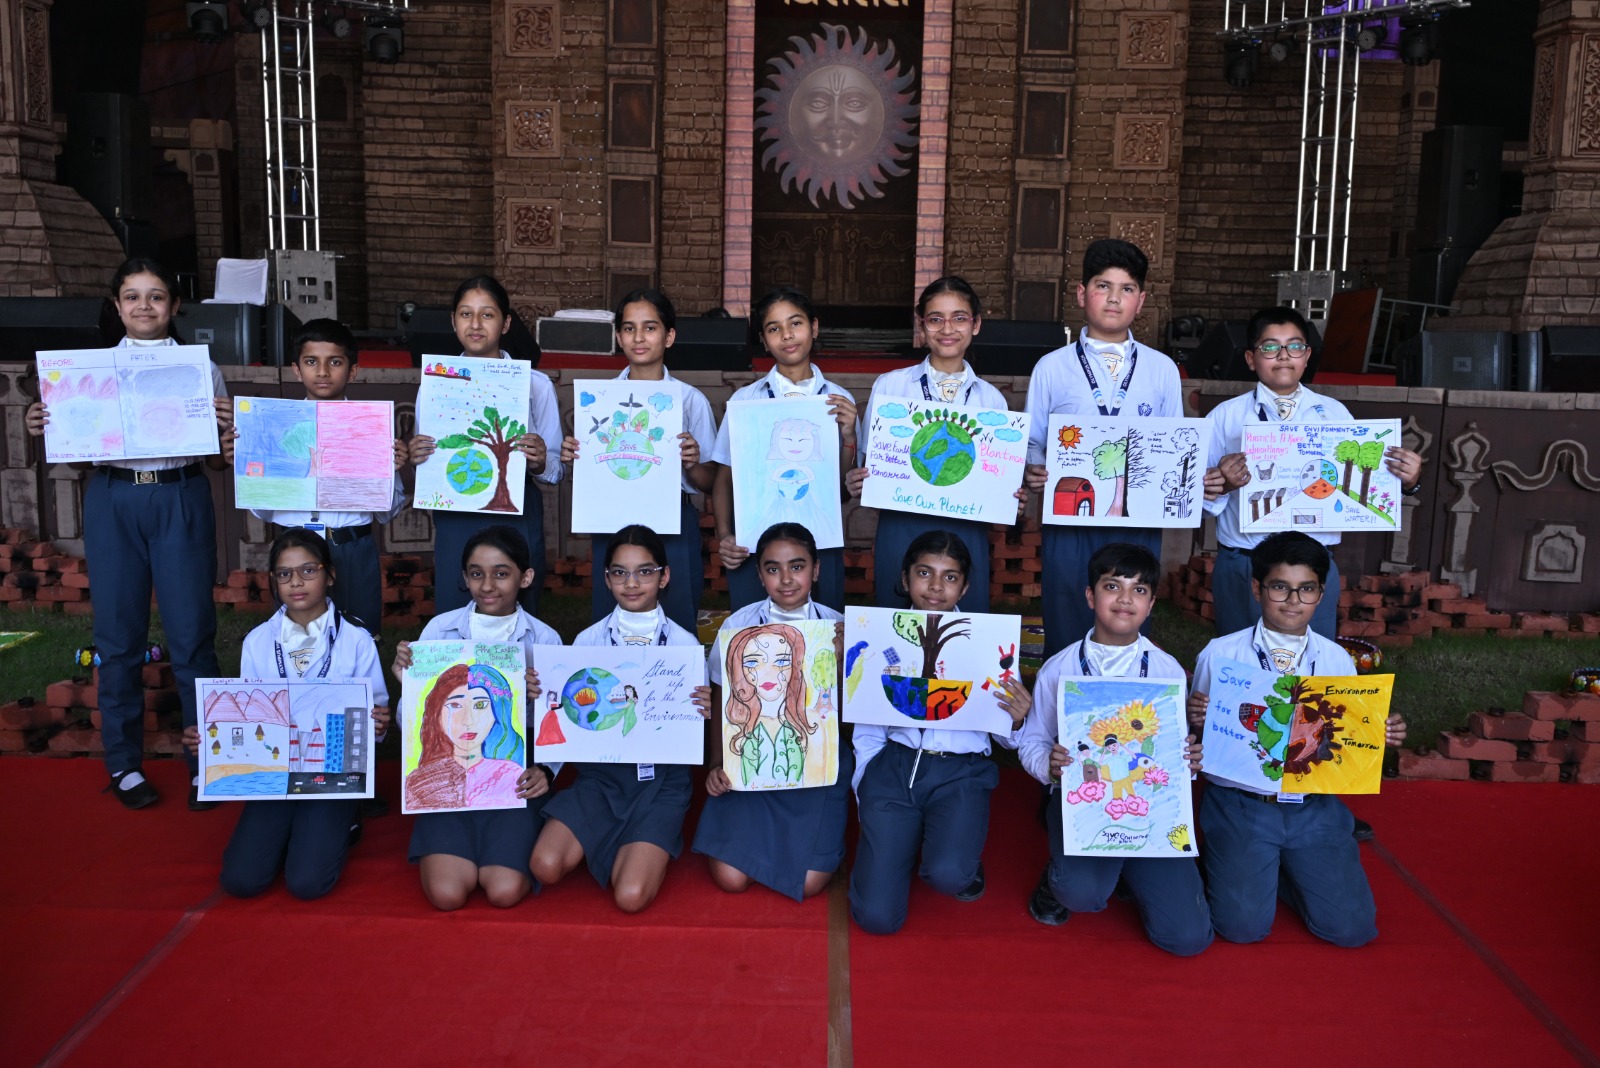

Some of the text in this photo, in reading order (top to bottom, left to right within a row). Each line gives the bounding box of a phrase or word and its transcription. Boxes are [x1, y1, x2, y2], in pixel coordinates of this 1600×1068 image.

[41, 359, 73, 368] BEFORE
[620, 439, 638, 451] SAVE
[872, 436, 892, 452] Save
[893, 487, 913, 505] Save
[916, 495, 937, 510] Our
[642, 659, 687, 680] Stand
[666, 677, 685, 692] up
[1218, 667, 1252, 690] Save
[643, 690, 676, 708] for the
[1215, 700, 1231, 715] for
[1362, 716, 1370, 724] a
[1213, 720, 1246, 741] better
